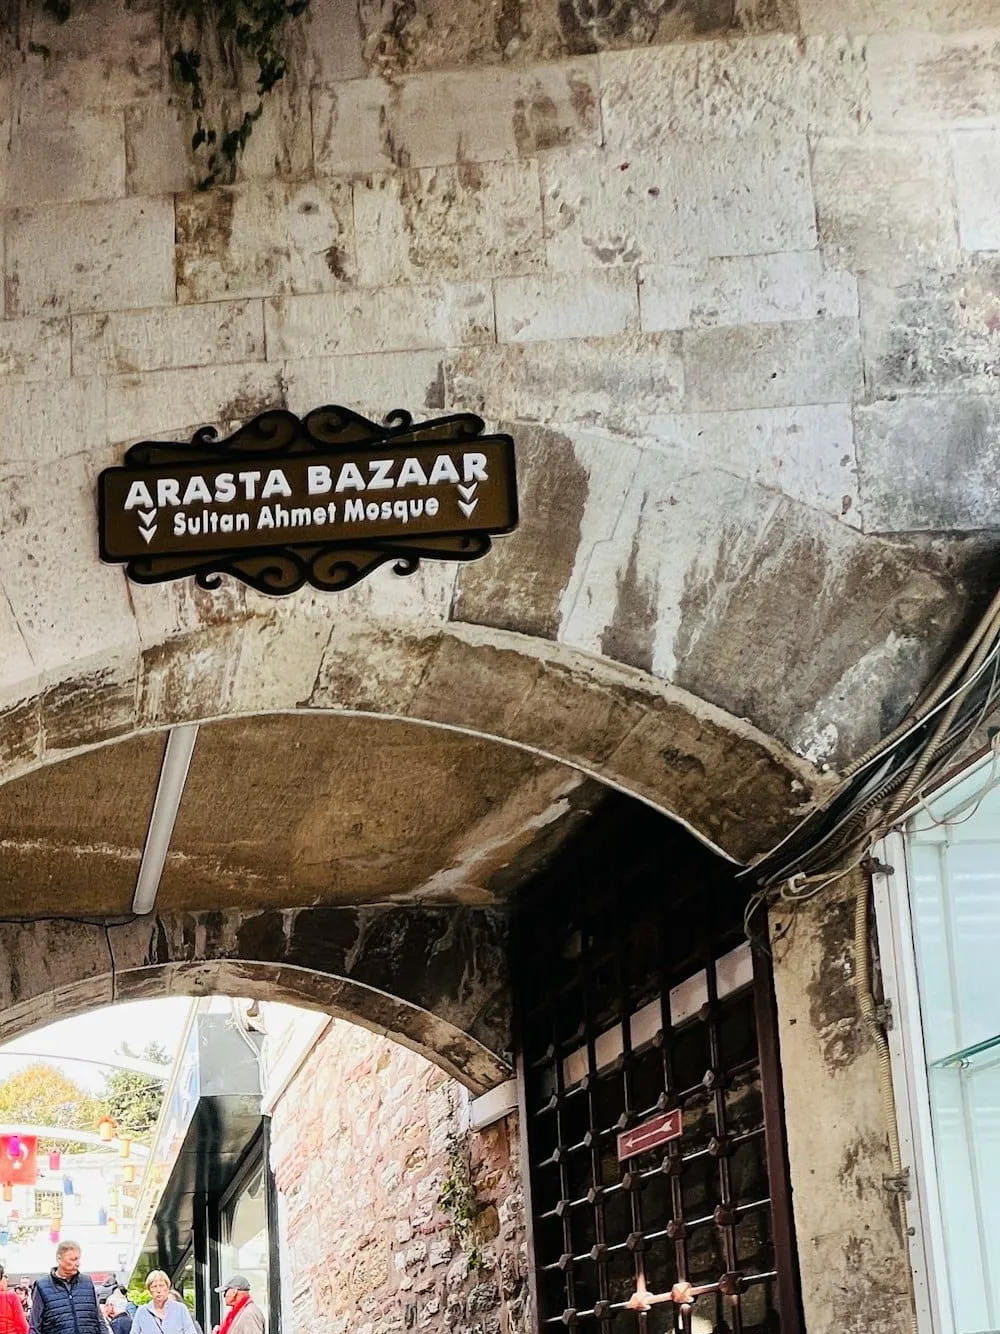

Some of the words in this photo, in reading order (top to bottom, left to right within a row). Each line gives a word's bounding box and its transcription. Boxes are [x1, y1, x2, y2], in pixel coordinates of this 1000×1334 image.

[124, 469, 292, 510] ARASTA
[307, 452, 490, 494] BAZAAR
[173, 508, 250, 536] Sultan
[257, 499, 337, 529] Ahmet
[344, 494, 440, 523] Mosque
